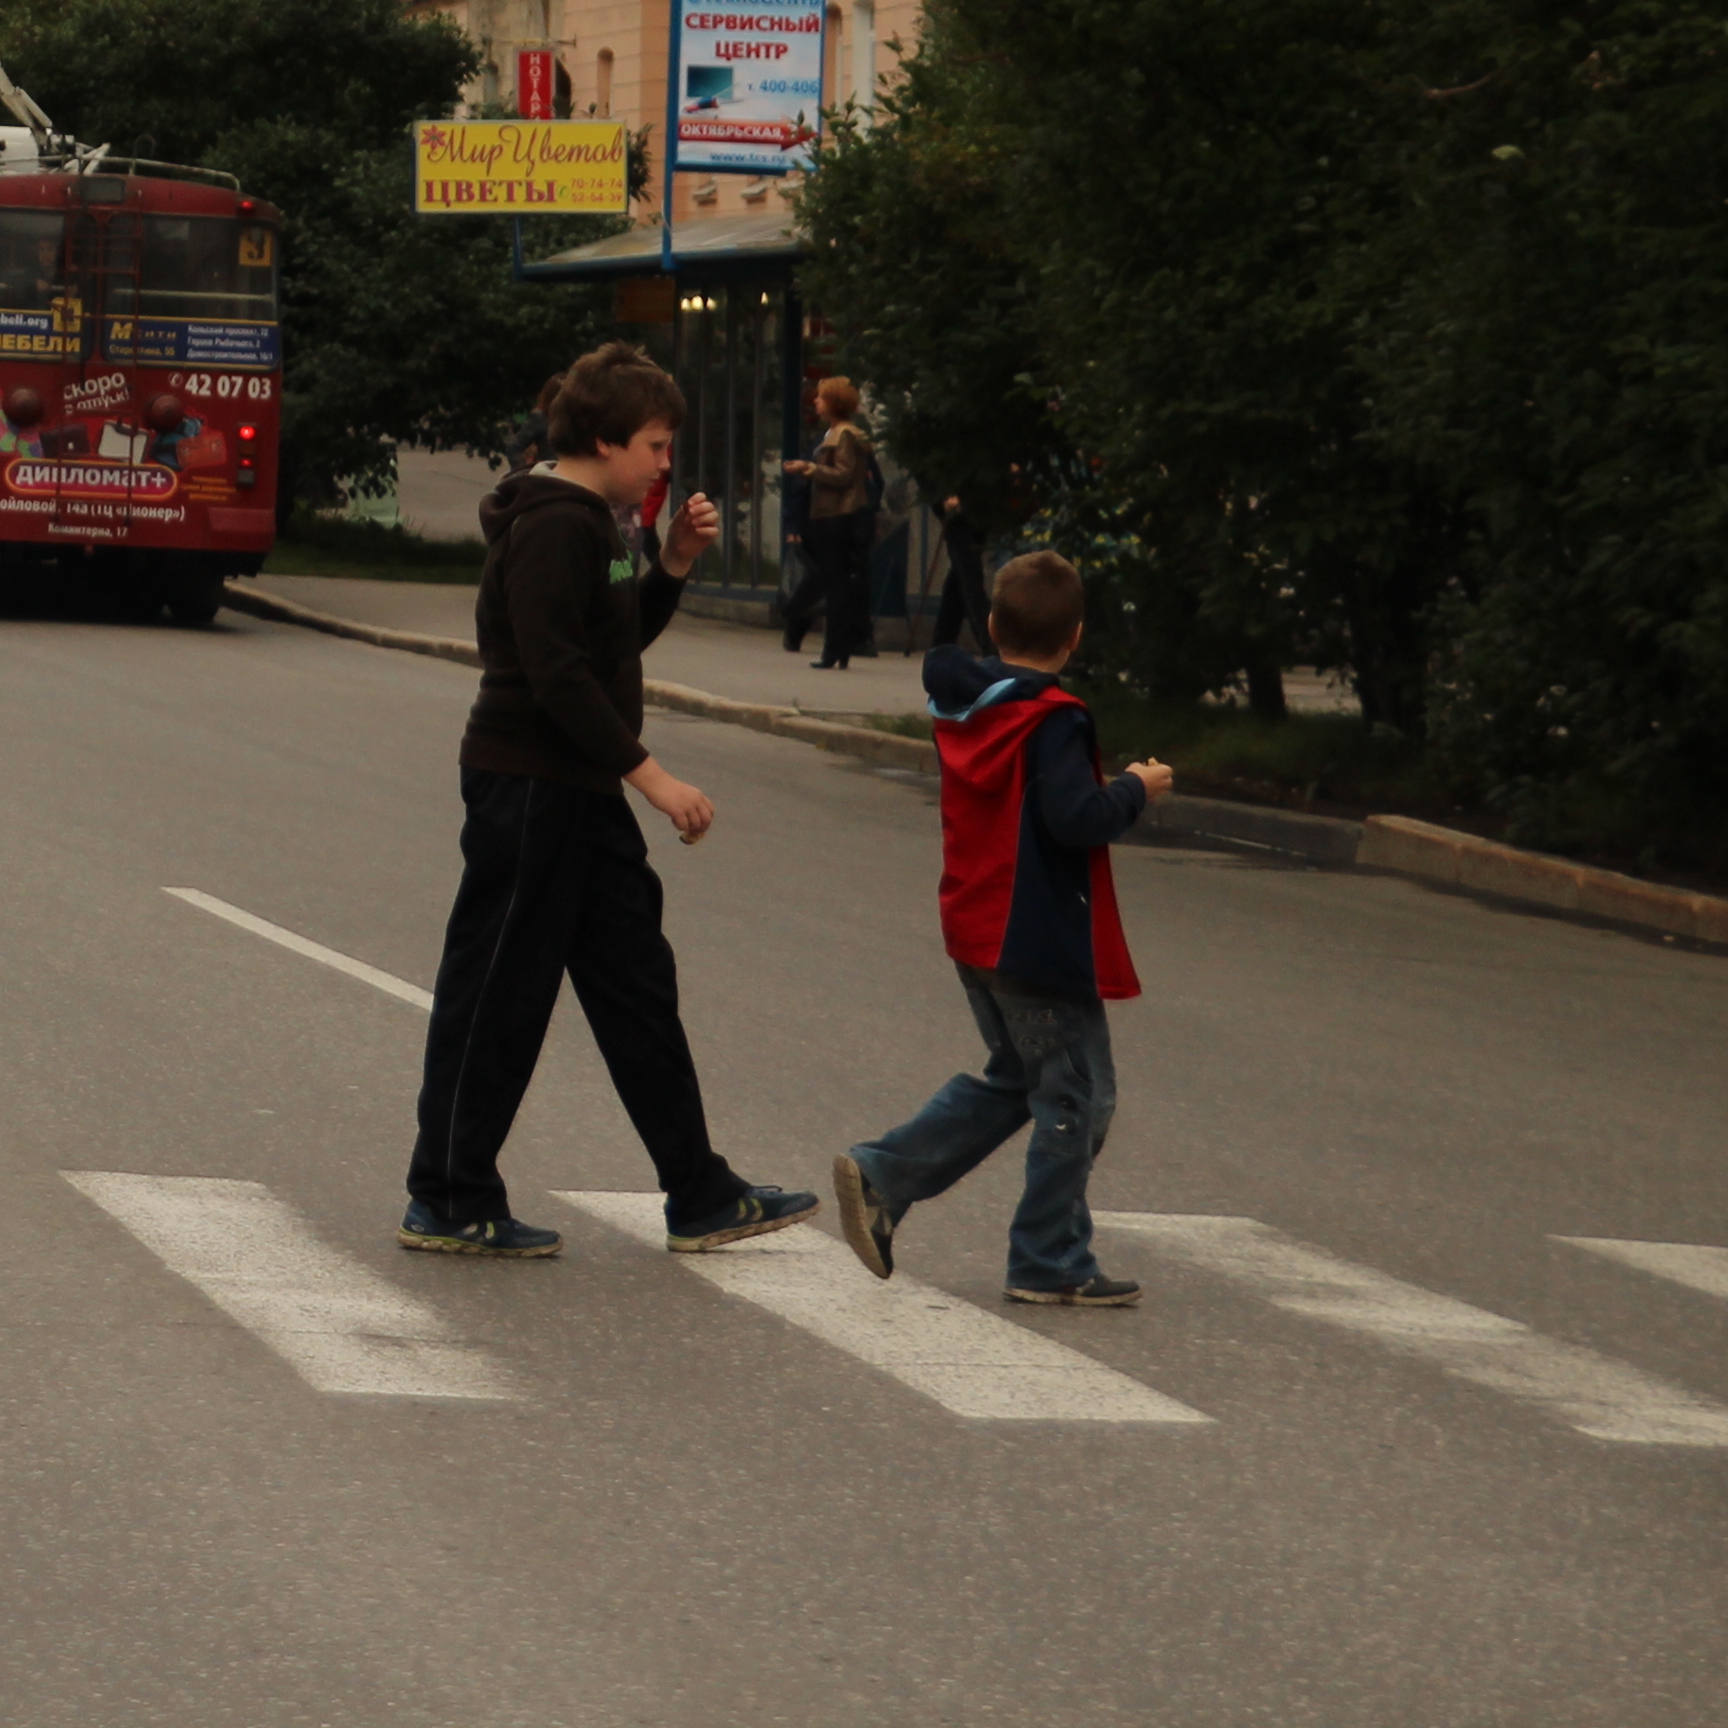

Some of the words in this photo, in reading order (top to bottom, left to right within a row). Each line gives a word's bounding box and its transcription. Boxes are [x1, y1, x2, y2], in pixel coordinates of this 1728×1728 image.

[684, 12, 820, 33] СЕРВИСНЫЙ
[715, 40, 788, 61] ЦЕНТР
[529, 53, 541, 119] НОТАР
[681, 124, 784, 140] ОКТЯБРЬСКАЯ,
[427, 125, 504, 177] Мир
[498, 124, 624, 177] Цветов
[423, 179, 557, 208] ЦВЕТЫ
[185, 373, 212, 396] 42
[217, 375, 243, 398] 07
[248, 376, 272, 399] 03
[116, 525, 128, 536] 17
